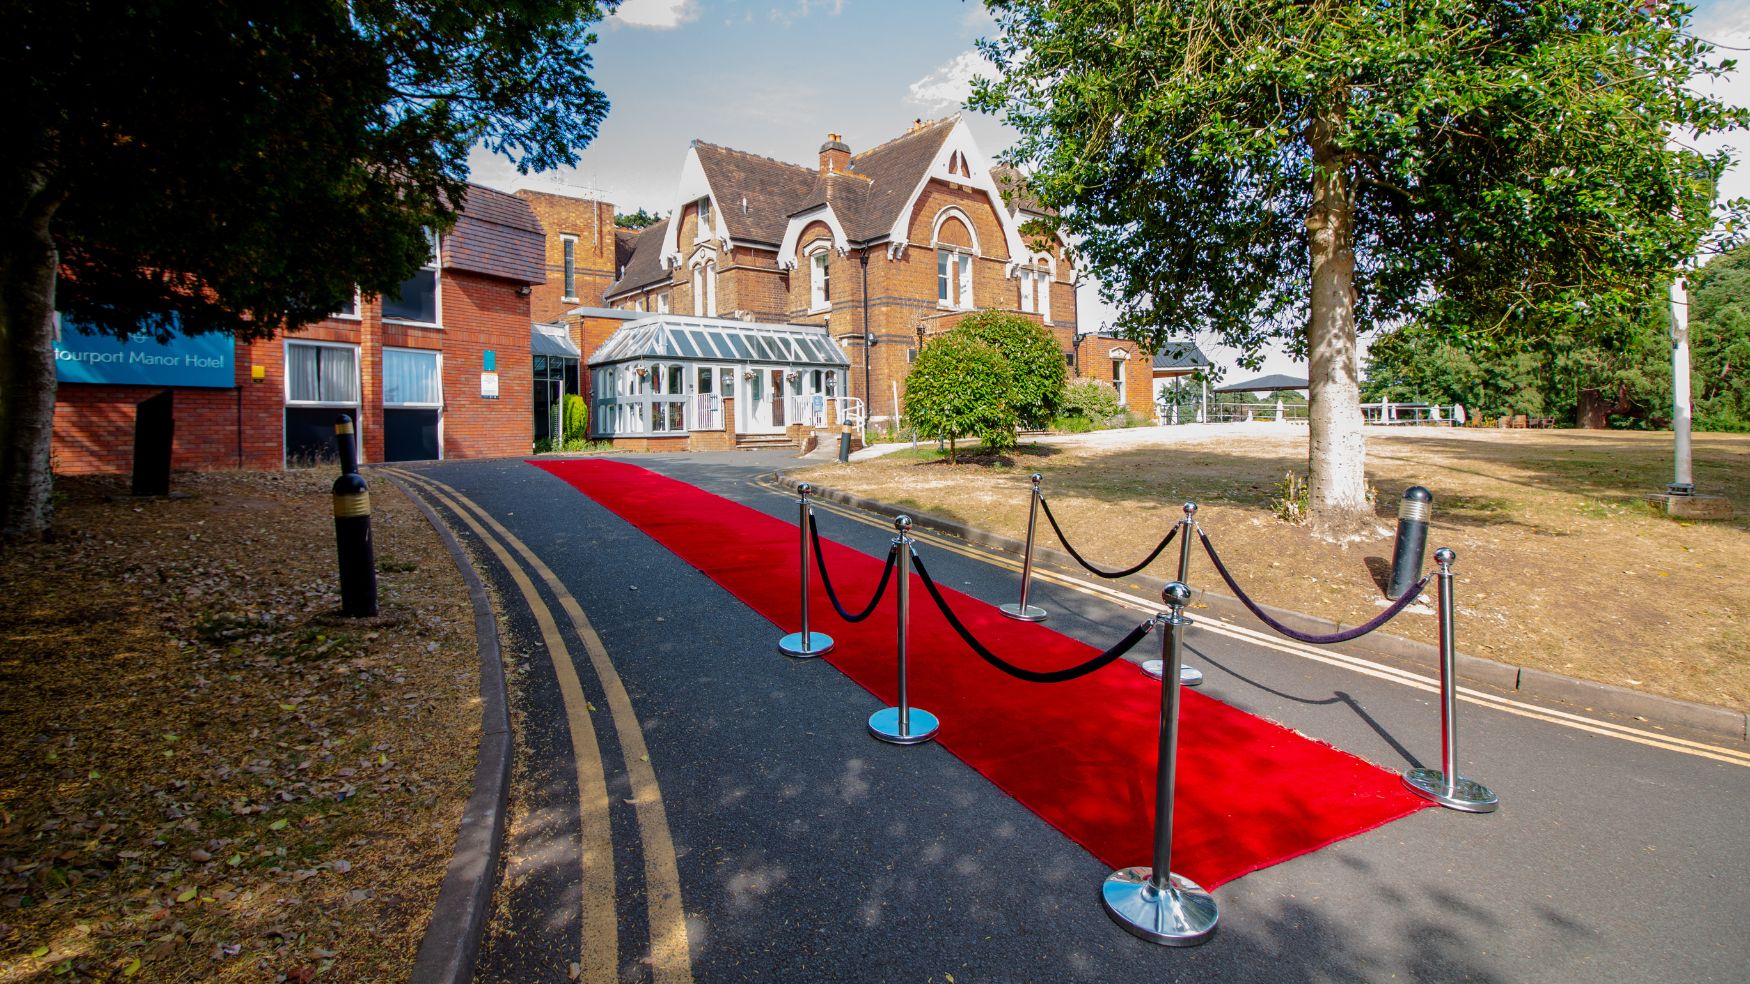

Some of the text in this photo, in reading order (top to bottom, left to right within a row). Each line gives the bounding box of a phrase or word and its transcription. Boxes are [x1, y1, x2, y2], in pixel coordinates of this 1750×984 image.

[53, 347, 224, 369] tourport Manor Hotel
